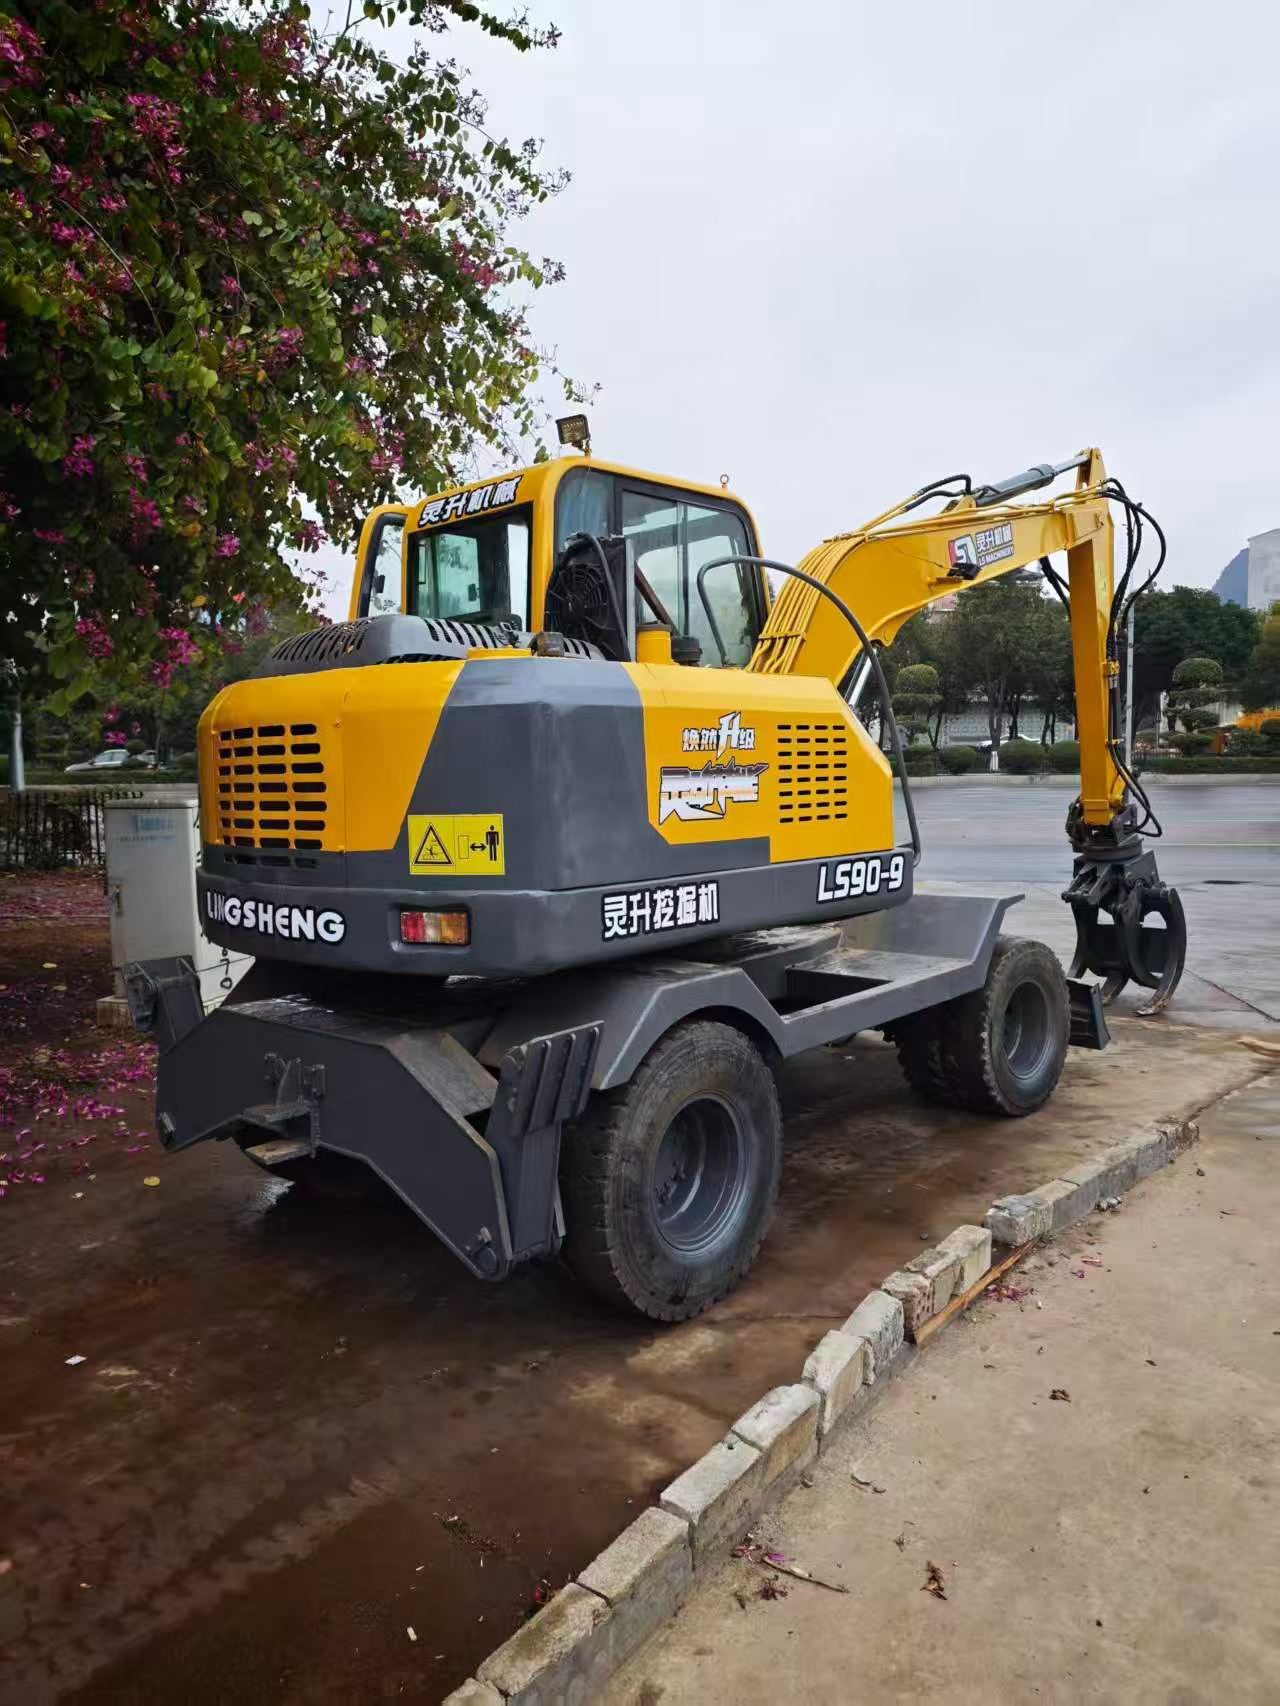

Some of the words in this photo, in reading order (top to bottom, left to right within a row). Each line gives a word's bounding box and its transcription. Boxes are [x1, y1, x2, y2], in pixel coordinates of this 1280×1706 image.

[419, 475, 522, 526] 灵升机械
[817, 855, 905, 902] LS90-9
[206, 890, 345, 943] LINGSHENG
[603, 883, 719, 939] 灵升挖掘机
